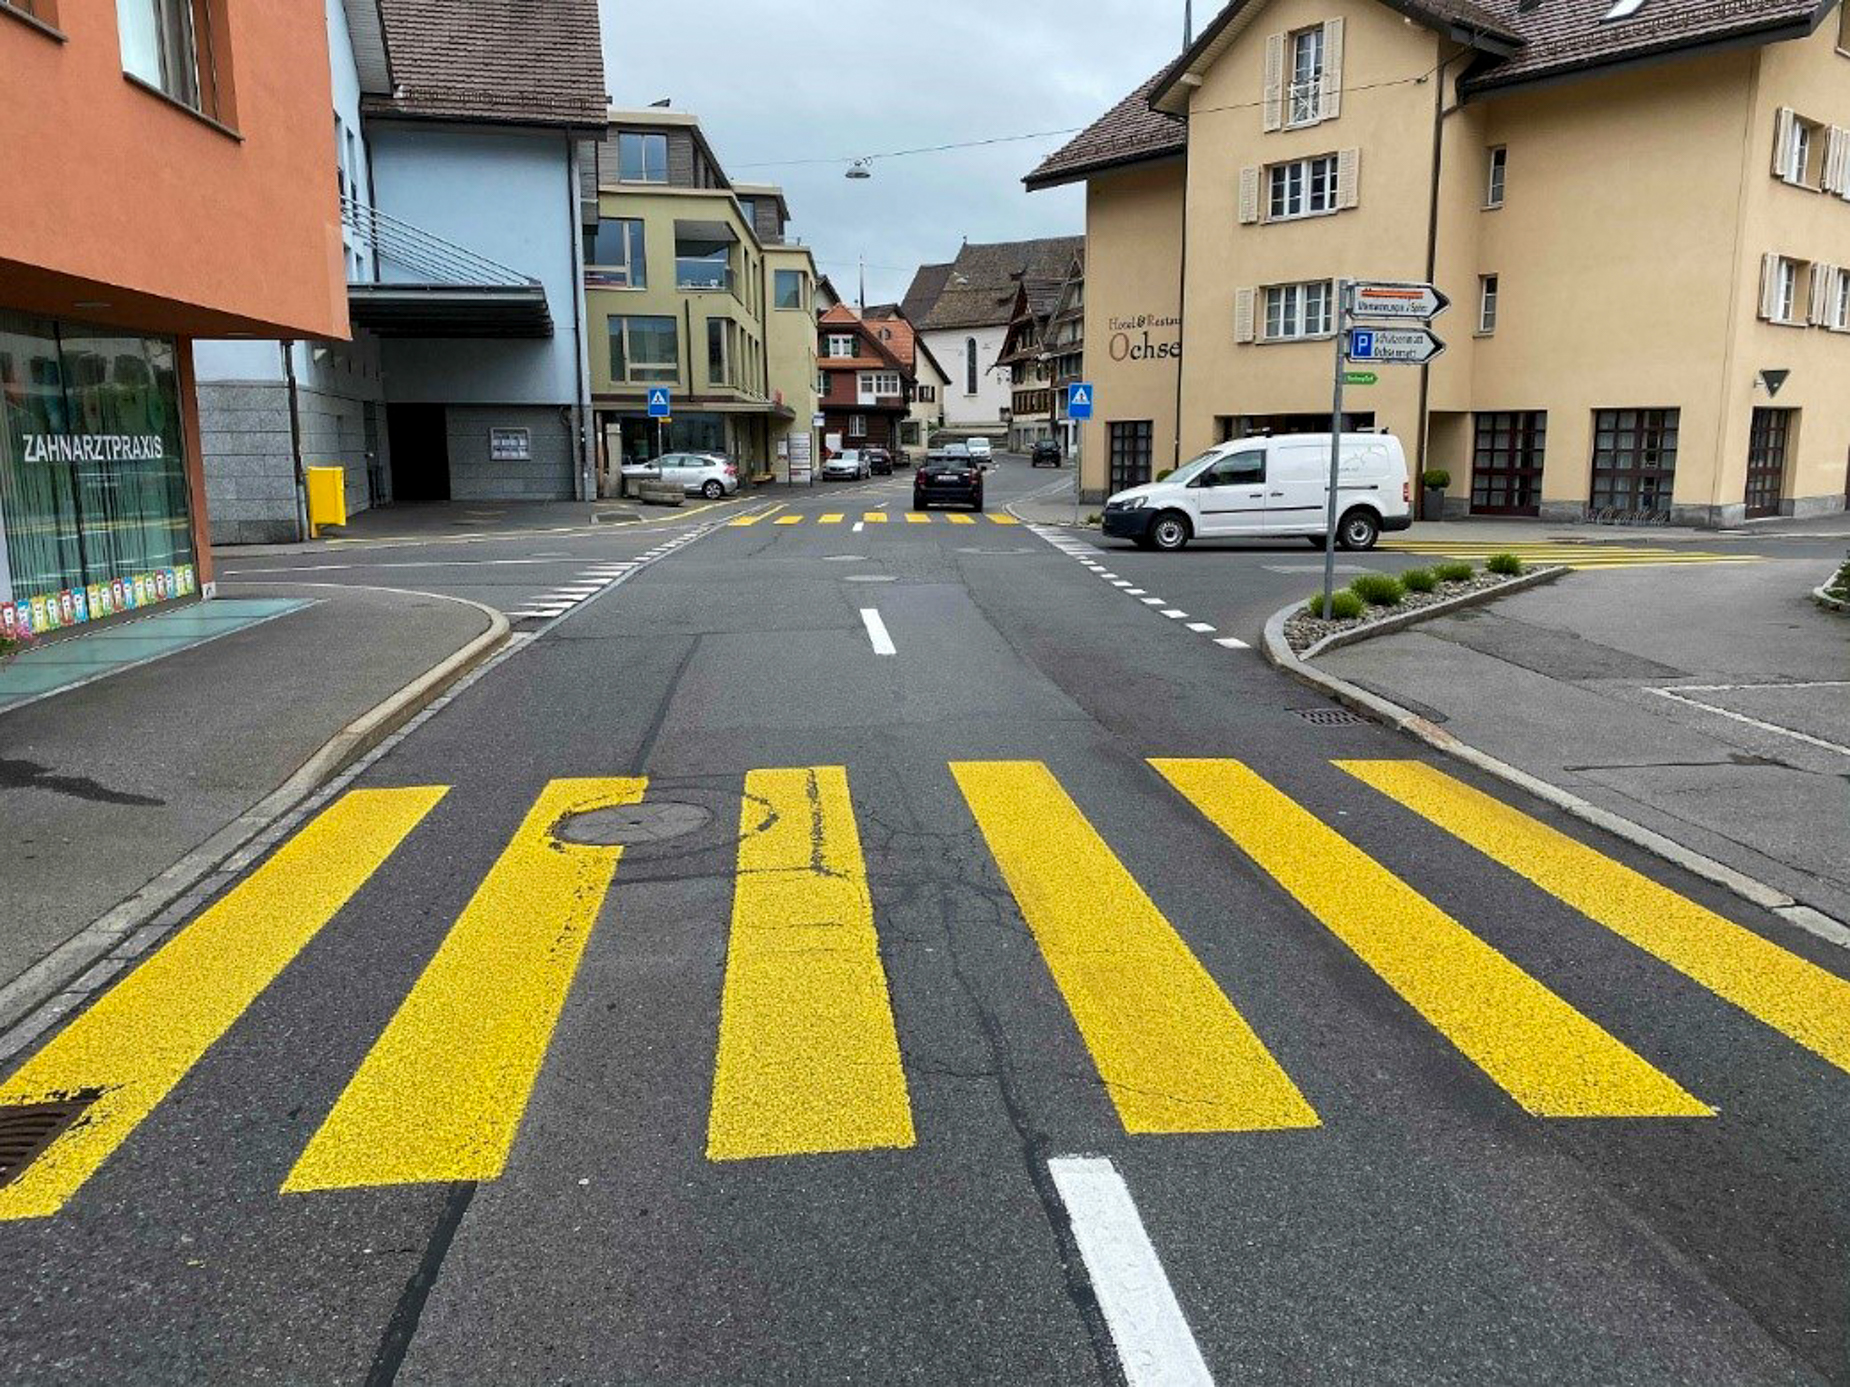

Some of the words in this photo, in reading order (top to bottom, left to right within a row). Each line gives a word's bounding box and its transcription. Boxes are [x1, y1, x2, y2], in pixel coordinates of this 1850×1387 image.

[1109, 317, 1136, 330] Hotel
[1358, 335, 1368, 353] P
[23, 434, 163, 461] ZAHNARZTPRAXIS
